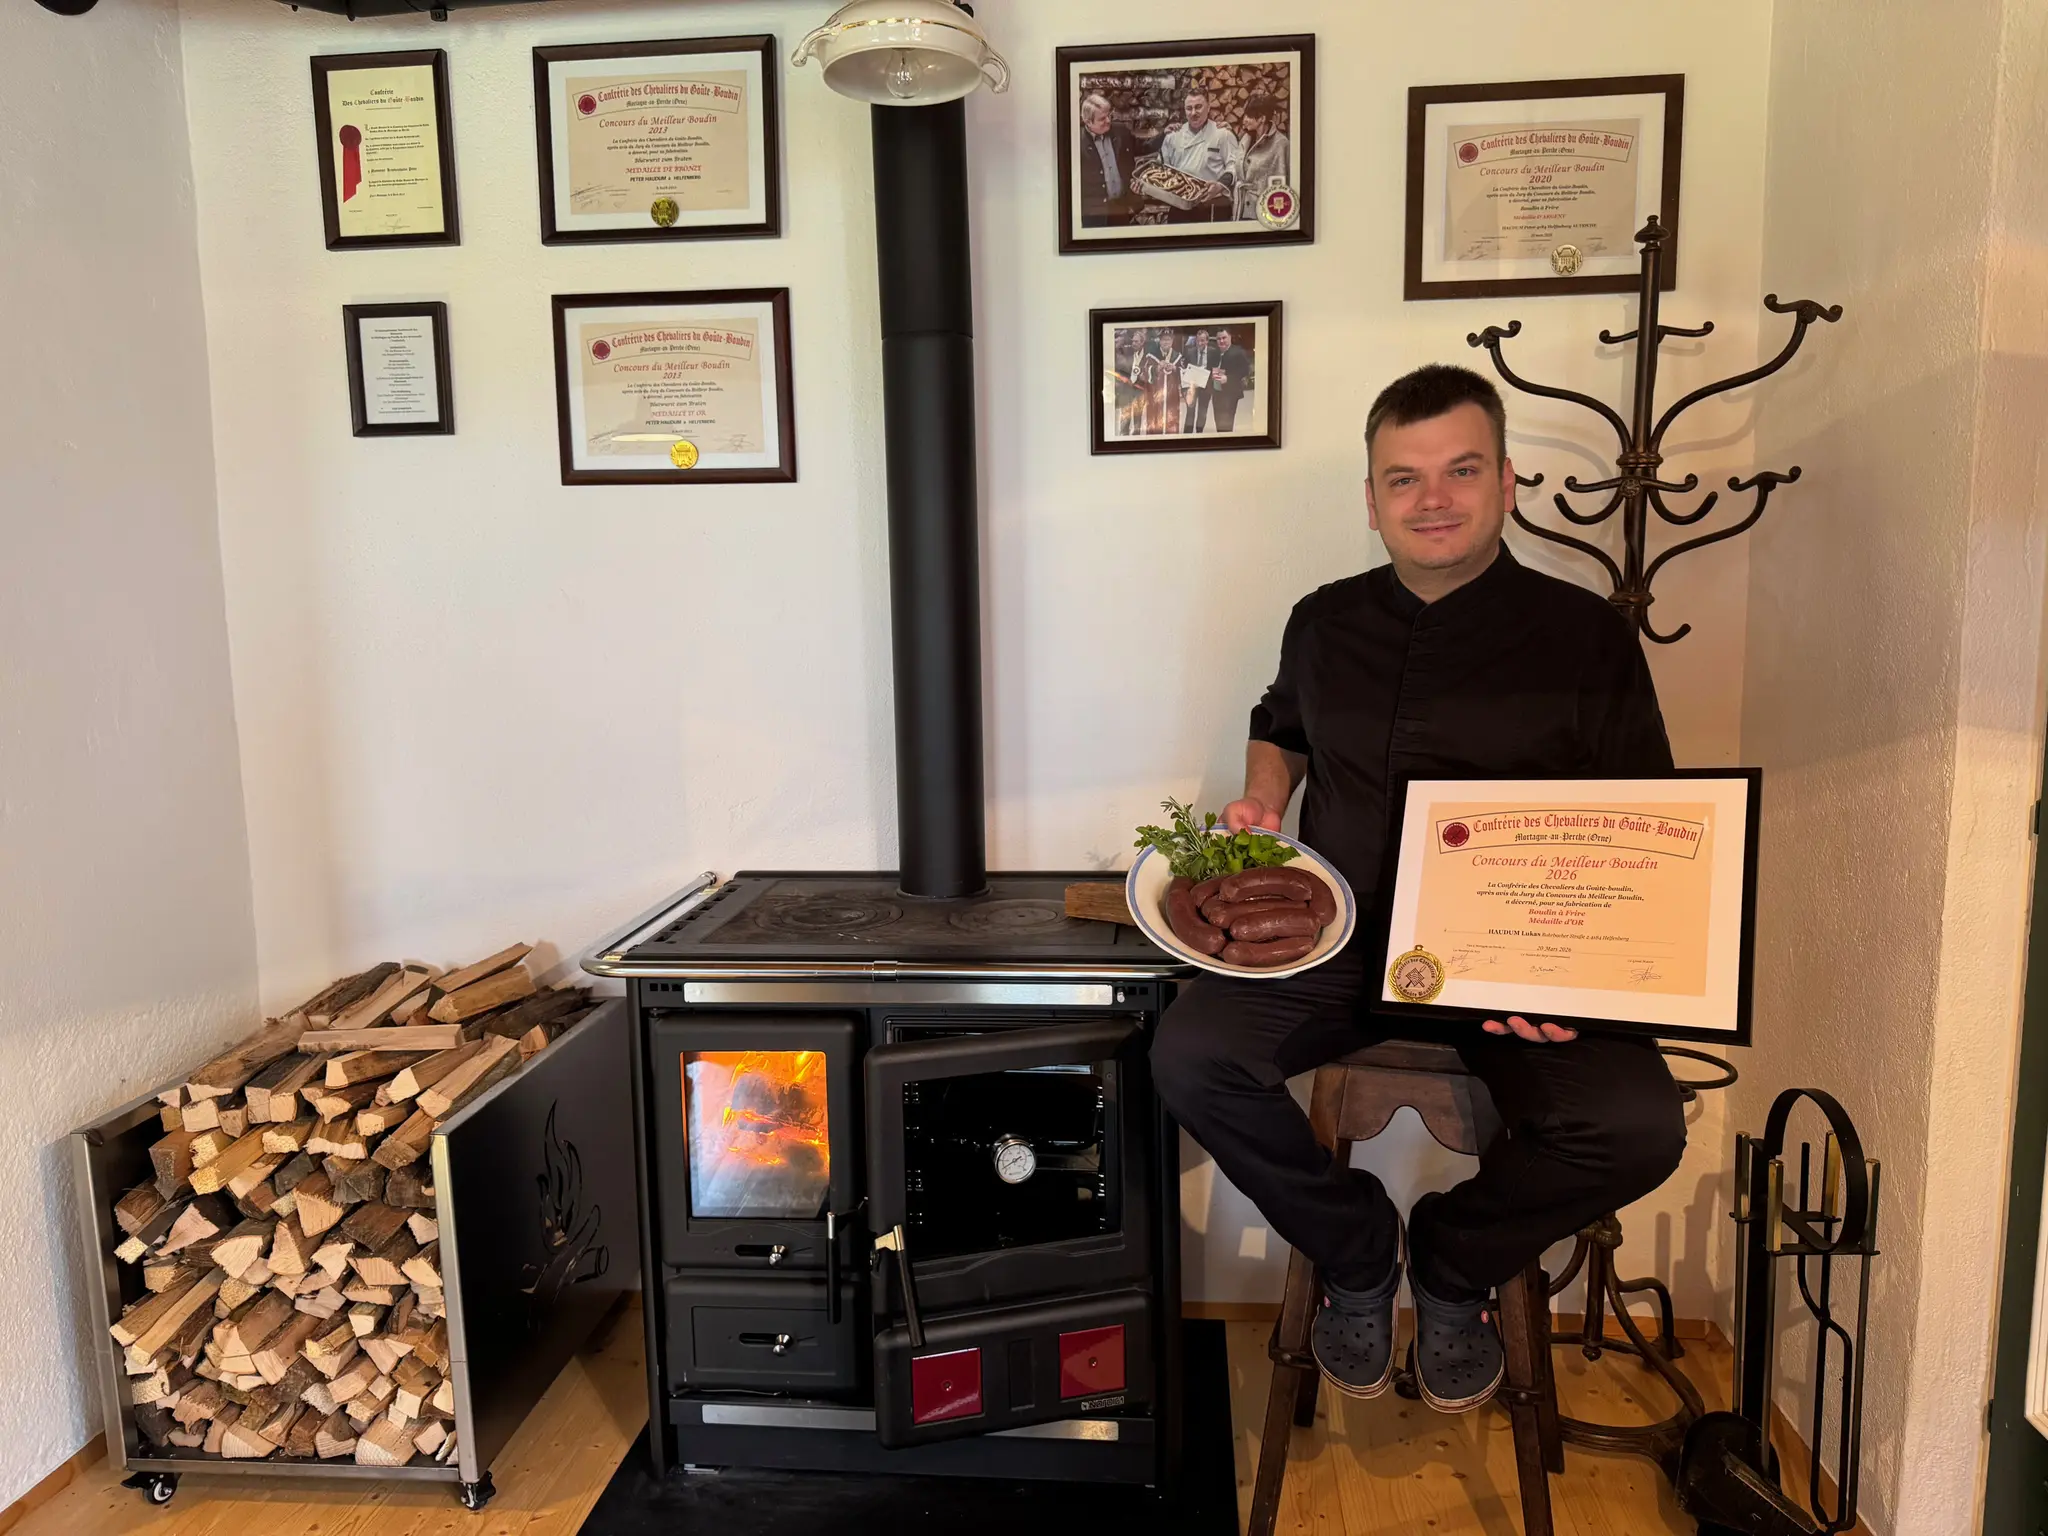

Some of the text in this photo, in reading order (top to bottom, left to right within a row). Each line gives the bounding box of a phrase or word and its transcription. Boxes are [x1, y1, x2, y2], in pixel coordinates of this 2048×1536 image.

[598, 86, 629, 102] Confrérie
[630, 86, 642, 96] des
[643, 84, 679, 96] Chevaliers
[680, 84, 688, 95] du
[599, 113, 717, 128] Concours du Meilleur Boudin
[648, 126, 668, 134] 2013
[1480, 135, 1514, 150] Confrérie
[1515, 135, 1527, 145] des
[1529, 132, 1566, 145] Chevaliers
[1568, 133, 1576, 143] du
[1480, 162, 1605, 176] Concours du Meilleur Boudin
[1529, 175, 1552, 183] 2020
[612, 333, 642, 348] Confrérie
[643, 333, 655, 343] des
[656, 331, 691, 342] Chevaliers
[692, 332, 701, 340] du
[614, 360, 730, 373] Concours du Meilleur Boudin
[1473, 815, 1521, 832] Confrérie
[1524, 816, 1541, 828] des
[1544, 814, 1599, 829] Chevaliers
[1602, 816, 1615, 828] du
[1588, 833, 1612, 844] (Orne)
[1472, 854, 1658, 869] Concours du Meilleur Boudin
[1545, 869, 1578, 880] 2026
[1528, 908, 1556, 916] Boudin
[1528, 917, 1584, 926] Médaille d'OR
